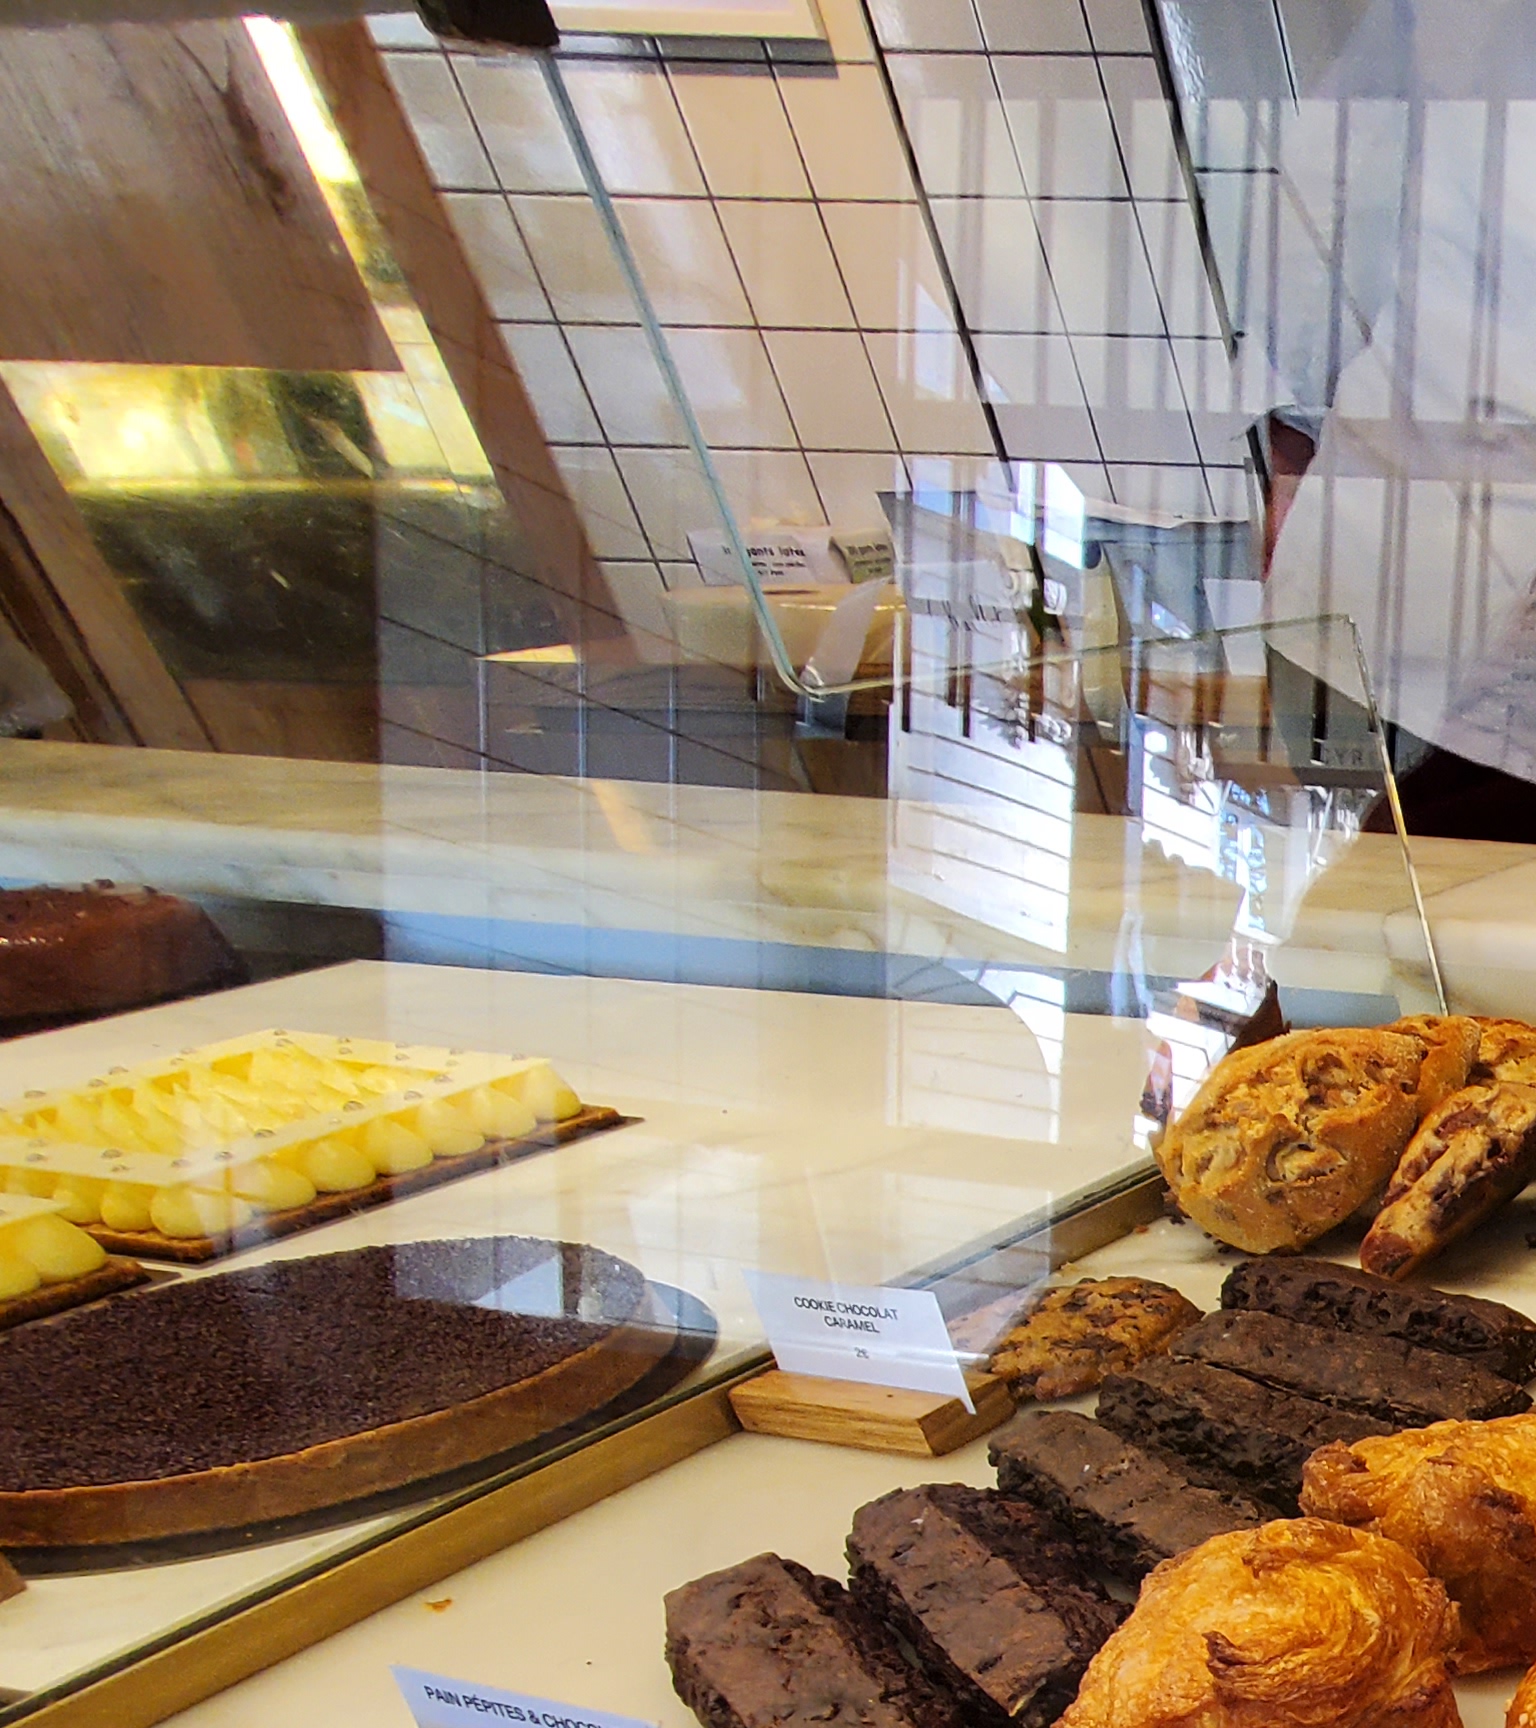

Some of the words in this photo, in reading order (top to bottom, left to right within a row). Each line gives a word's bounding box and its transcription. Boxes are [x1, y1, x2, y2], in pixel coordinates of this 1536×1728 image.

[793, 1295, 836, 1313] COOKIE
[836, 1301, 899, 1321] CHOCOLAT
[823, 1315, 881, 1334] CARAMEL
[422, 1684, 463, 1708] PAIN
[462, 1693, 527, 1723] PÉPITES
[527, 1709, 541, 1726] &
